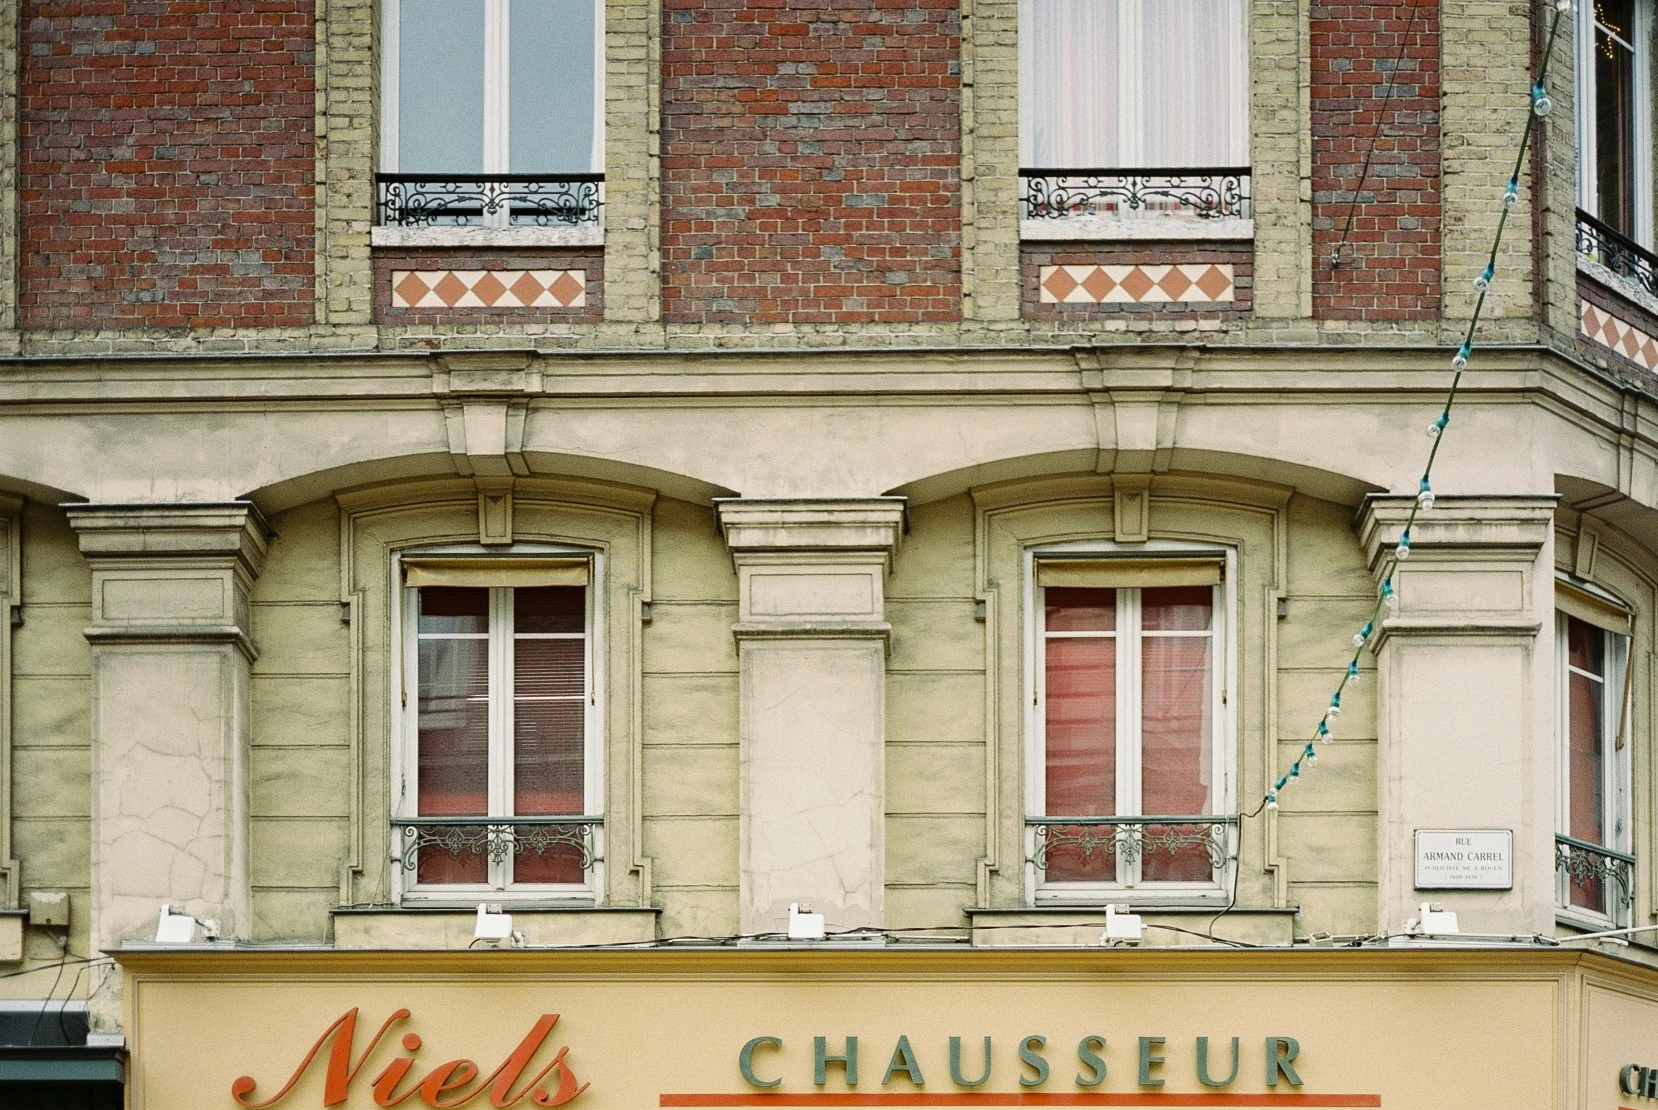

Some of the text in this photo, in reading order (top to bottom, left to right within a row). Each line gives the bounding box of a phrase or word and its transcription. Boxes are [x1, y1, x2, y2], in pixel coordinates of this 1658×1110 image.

[1423, 852, 1504, 861] ARMAND CARREL
[1455, 837, 1473, 846] RUE
[231, 1006, 591, 1109] Niels
[737, 1033, 1305, 1089] CHAUSSEUR
[1618, 1063, 1658, 1099] CH
